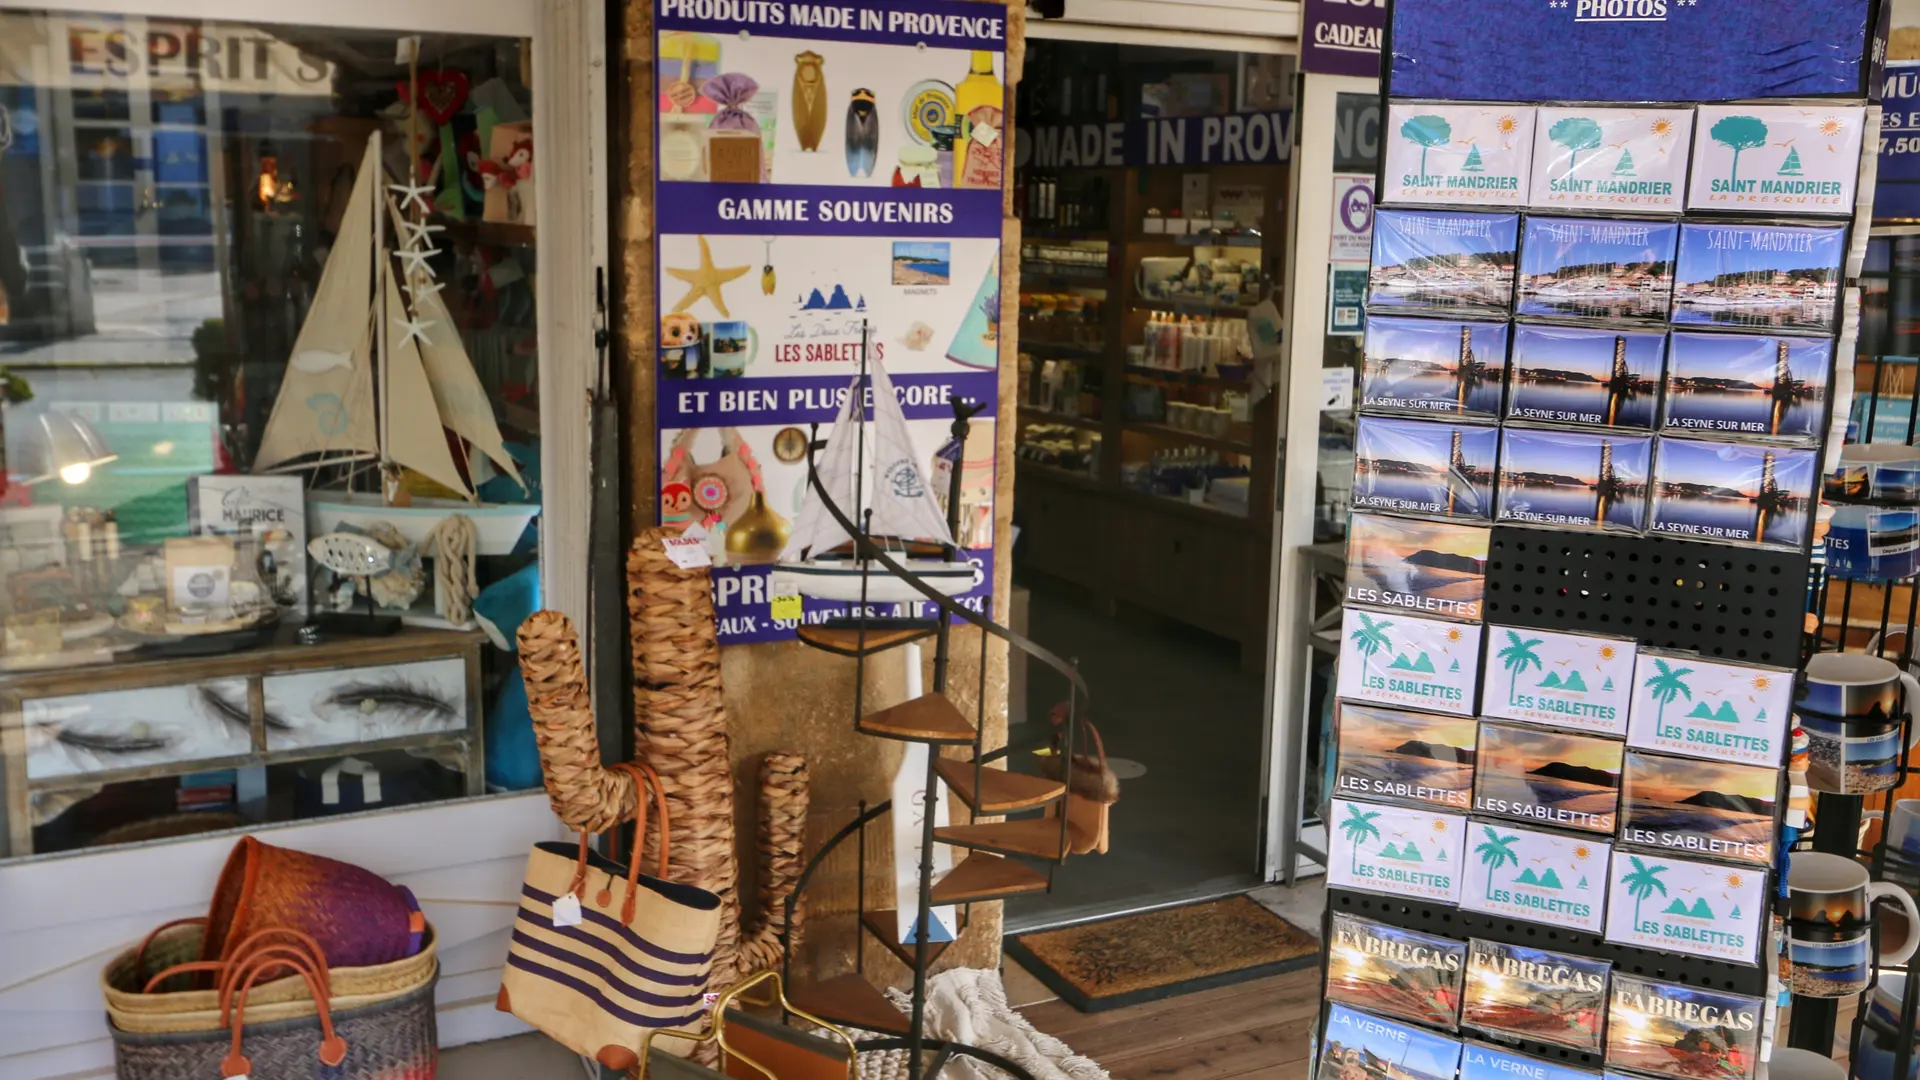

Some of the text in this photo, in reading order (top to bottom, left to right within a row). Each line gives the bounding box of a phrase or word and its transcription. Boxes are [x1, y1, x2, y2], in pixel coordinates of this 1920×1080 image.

[661, 0, 1004, 40] PRODUITS MADE IN PROVENCE
[1576, 0, 1667, 17] PHOTOS
[69, 30, 277, 81] ESPRIT
[1034, 122, 1125, 167] MADE
[1147, 119, 1186, 164] IN
[1402, 174, 1518, 189] SAINT MANDRIER
[1550, 178, 1672, 195] SAINT MANDRIER
[1711, 178, 1841, 195] SAINT MANDRIER
[718, 198, 954, 224] GAMME SOUVENIRS
[1707, 229, 1813, 253] SAINT-MANDRIER
[775, 343, 801, 362] LES
[678, 391, 709, 414] ET
[719, 389, 778, 412] BIEN
[788, 386, 849, 410] PLUS
[1363, 396, 1451, 411] LA SEYNE SUR MER
[1509, 407, 1602, 423] LA SEYNE SUR MER
[1666, 417, 1764, 432] LA SEYNE SUR MER
[1355, 496, 1441, 512] LA SEYNE SUR MER
[1499, 510, 1590, 526] LA SEYNE SUR MER
[1652, 522, 1749, 539] LA SEYNE SUR MER
[1348, 586, 1477, 616] LES SABLETTES
[1362, 675, 1385, 689] LES
[1389, 678, 1463, 701] SABLETTES
[1509, 695, 1616, 720] LES SABLETTES
[1656, 725, 1682, 740] LES
[1686, 728, 1770, 752] SABLETTES
[1340, 775, 1467, 805] LES SABLETTES
[1477, 797, 1611, 829] LES SABLETTES
[1624, 828, 1767, 858] LES SABLETTES
[1352, 864, 1375, 877] LES
[1378, 867, 1450, 888] SABLETTES
[1486, 889, 1510, 902] LES
[1514, 893, 1590, 917] SABLETTES
[1634, 920, 1659, 934] LES
[1663, 924, 1744, 948] SABLETTES
[1337, 930, 1459, 971] FABREGAS
[1472, 951, 1602, 993] FABREGAS
[1616, 990, 1753, 1031] FABREGAS
[1333, 1012, 1408, 1043] LA VERNE
[1466, 1051, 1545, 1080] LA VERNE
